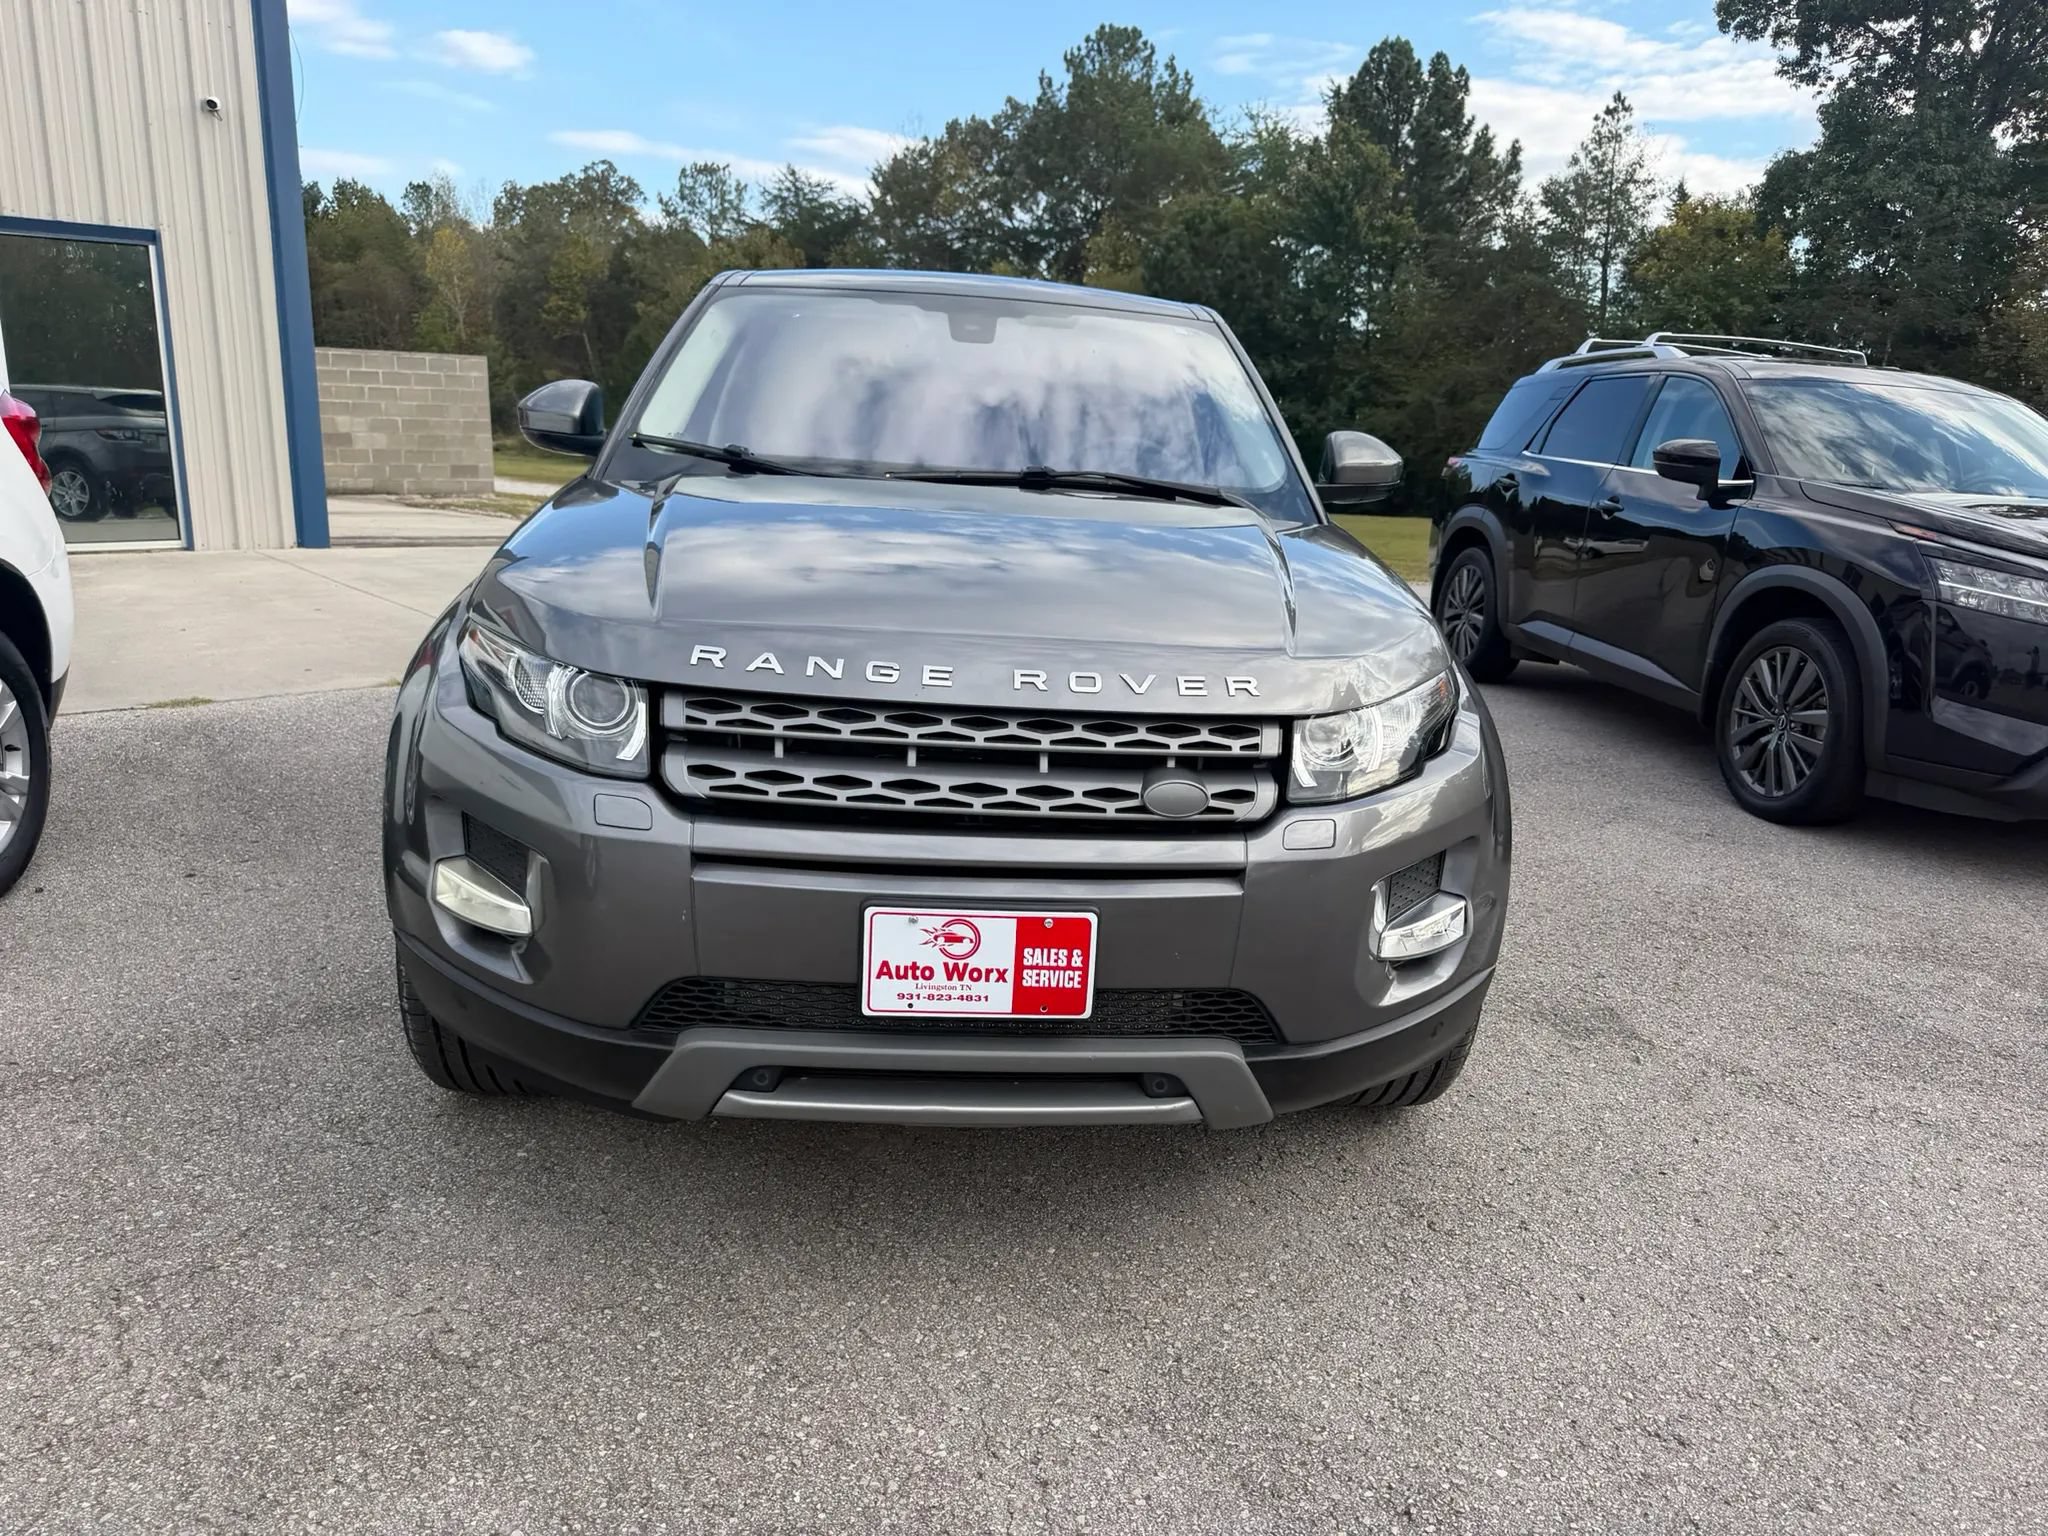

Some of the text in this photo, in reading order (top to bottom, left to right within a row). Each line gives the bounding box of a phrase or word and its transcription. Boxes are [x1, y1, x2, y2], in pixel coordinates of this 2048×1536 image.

[689, 644, 1261, 697] RANGE ROVER
[1023, 947, 1083, 967] SALES &
[875, 960, 1009, 983] Auto Worx
[1022, 969, 1083, 988] SERVICE
[896, 992, 990, 1002] 931-823-4831
[915, 983, 973, 992] Livingston TN
